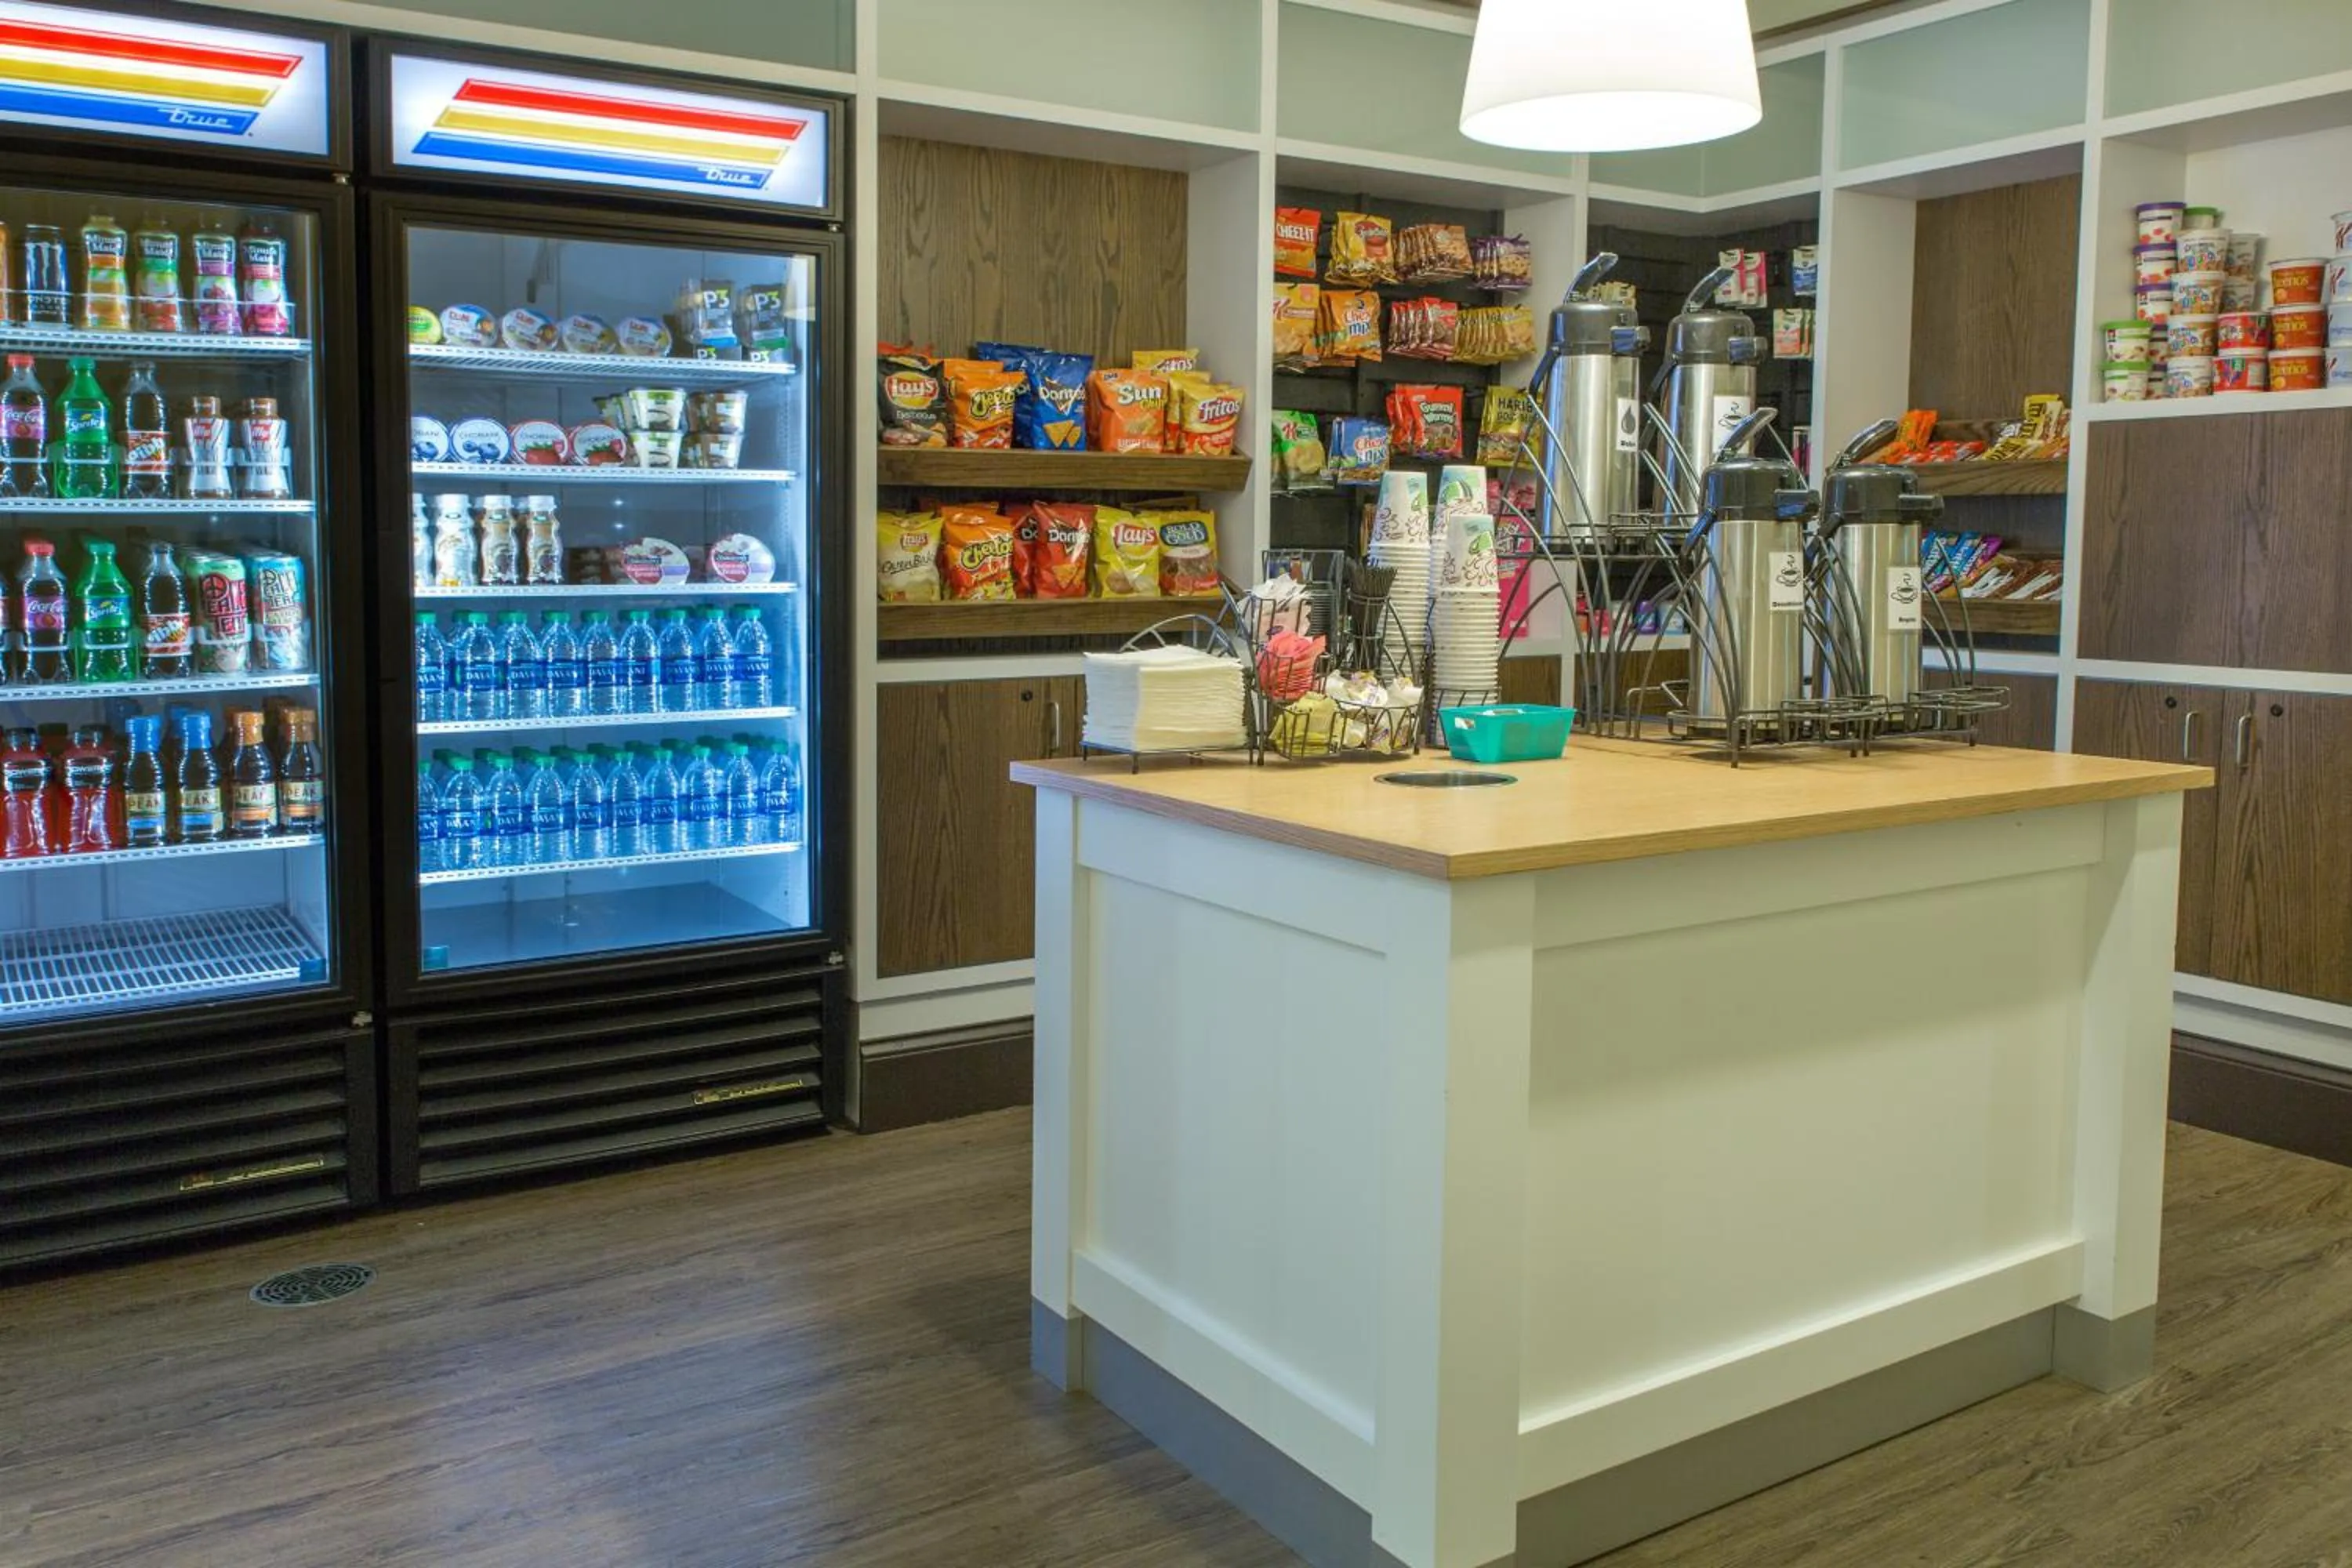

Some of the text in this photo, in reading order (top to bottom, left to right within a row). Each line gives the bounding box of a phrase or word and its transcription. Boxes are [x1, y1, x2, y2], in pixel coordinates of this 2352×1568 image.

[158, 107, 234, 129] True
[696, 165, 757, 184] True
[703, 289, 730, 308] P3
[754, 291, 781, 310] P3
[697, 347, 717, 361] P3
[750, 350, 770, 363] P3
[1117, 384, 1162, 405] Sun
[1198, 398, 1241, 423] Fritos
[1116, 524, 1156, 546] Lay's
